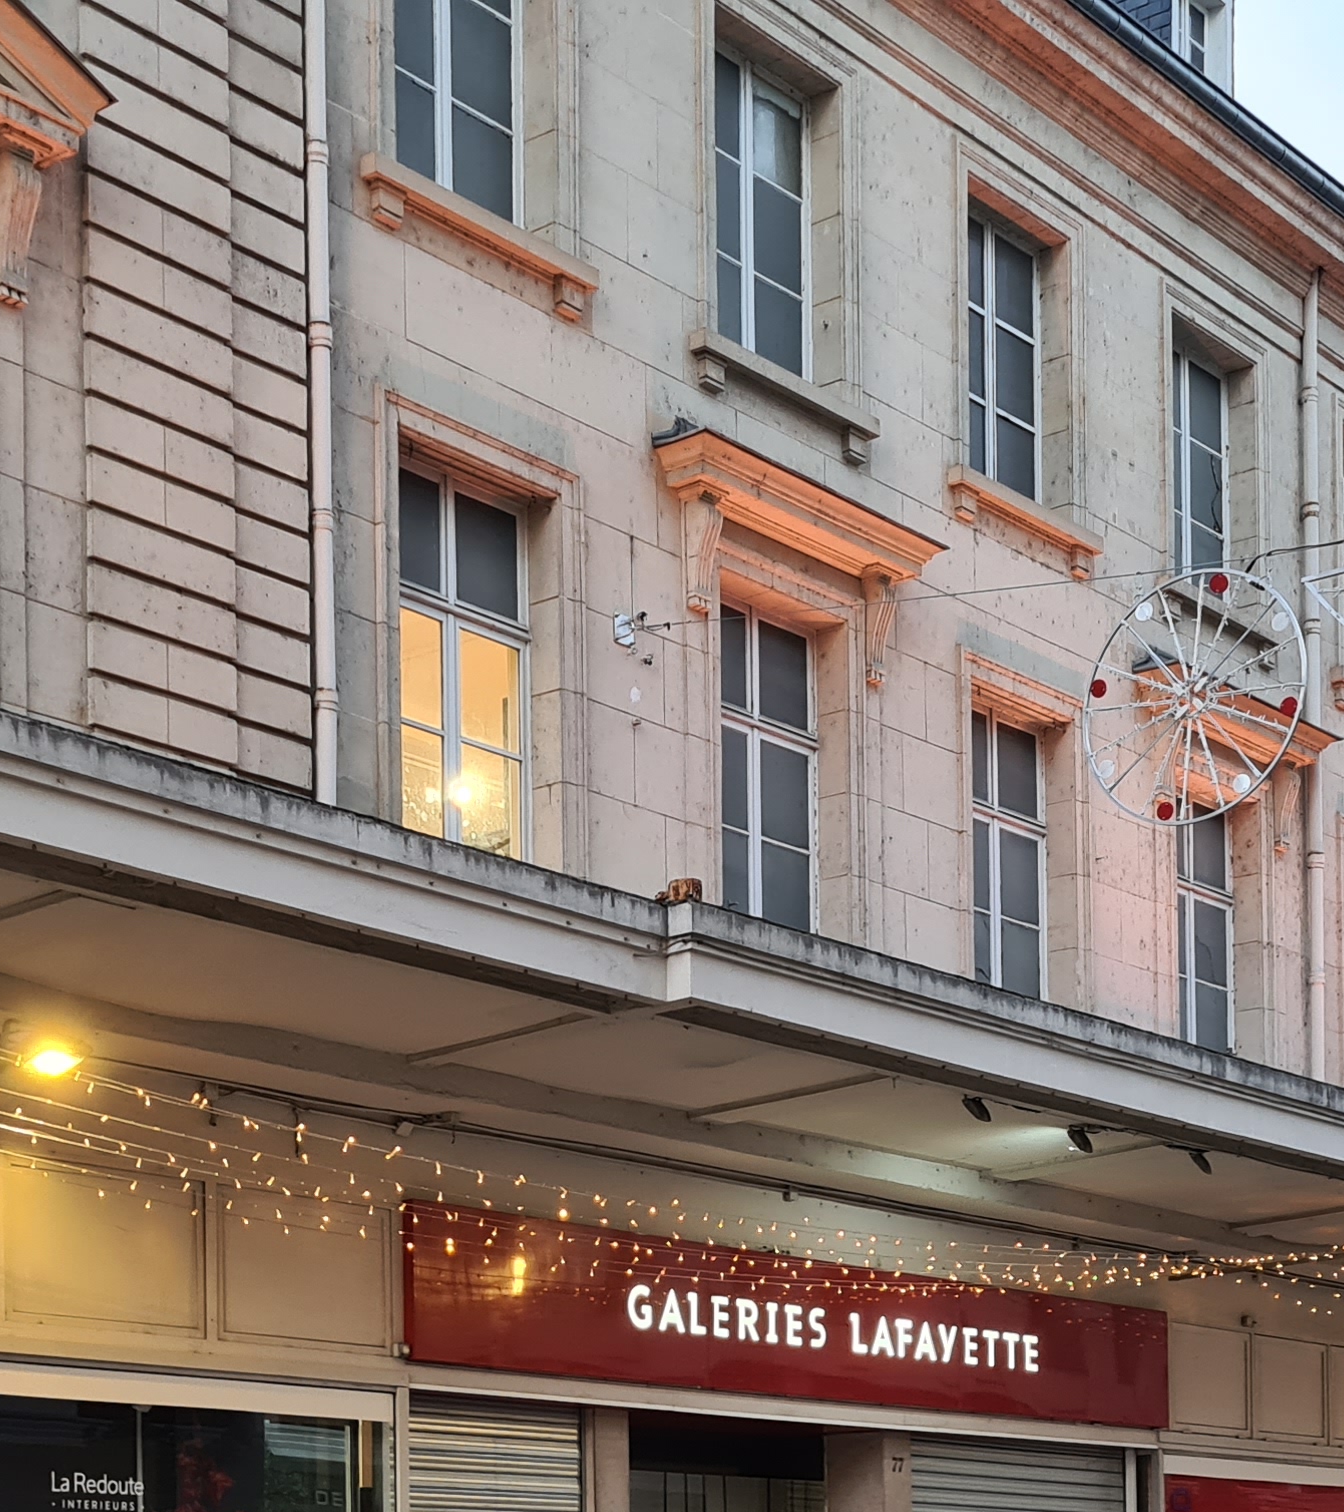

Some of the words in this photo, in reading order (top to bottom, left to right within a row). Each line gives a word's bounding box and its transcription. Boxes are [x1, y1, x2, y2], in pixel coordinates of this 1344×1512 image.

[626, 1283, 827, 1348] GALERIES
[849, 1312, 1040, 1373] LAFAYETTE
[892, 1457, 904, 1473] 77
[51, 1470, 70, 1493] La
[74, 1472, 144, 1496] Redoute
[61, 1499, 136, 1512] INTERIEURS
